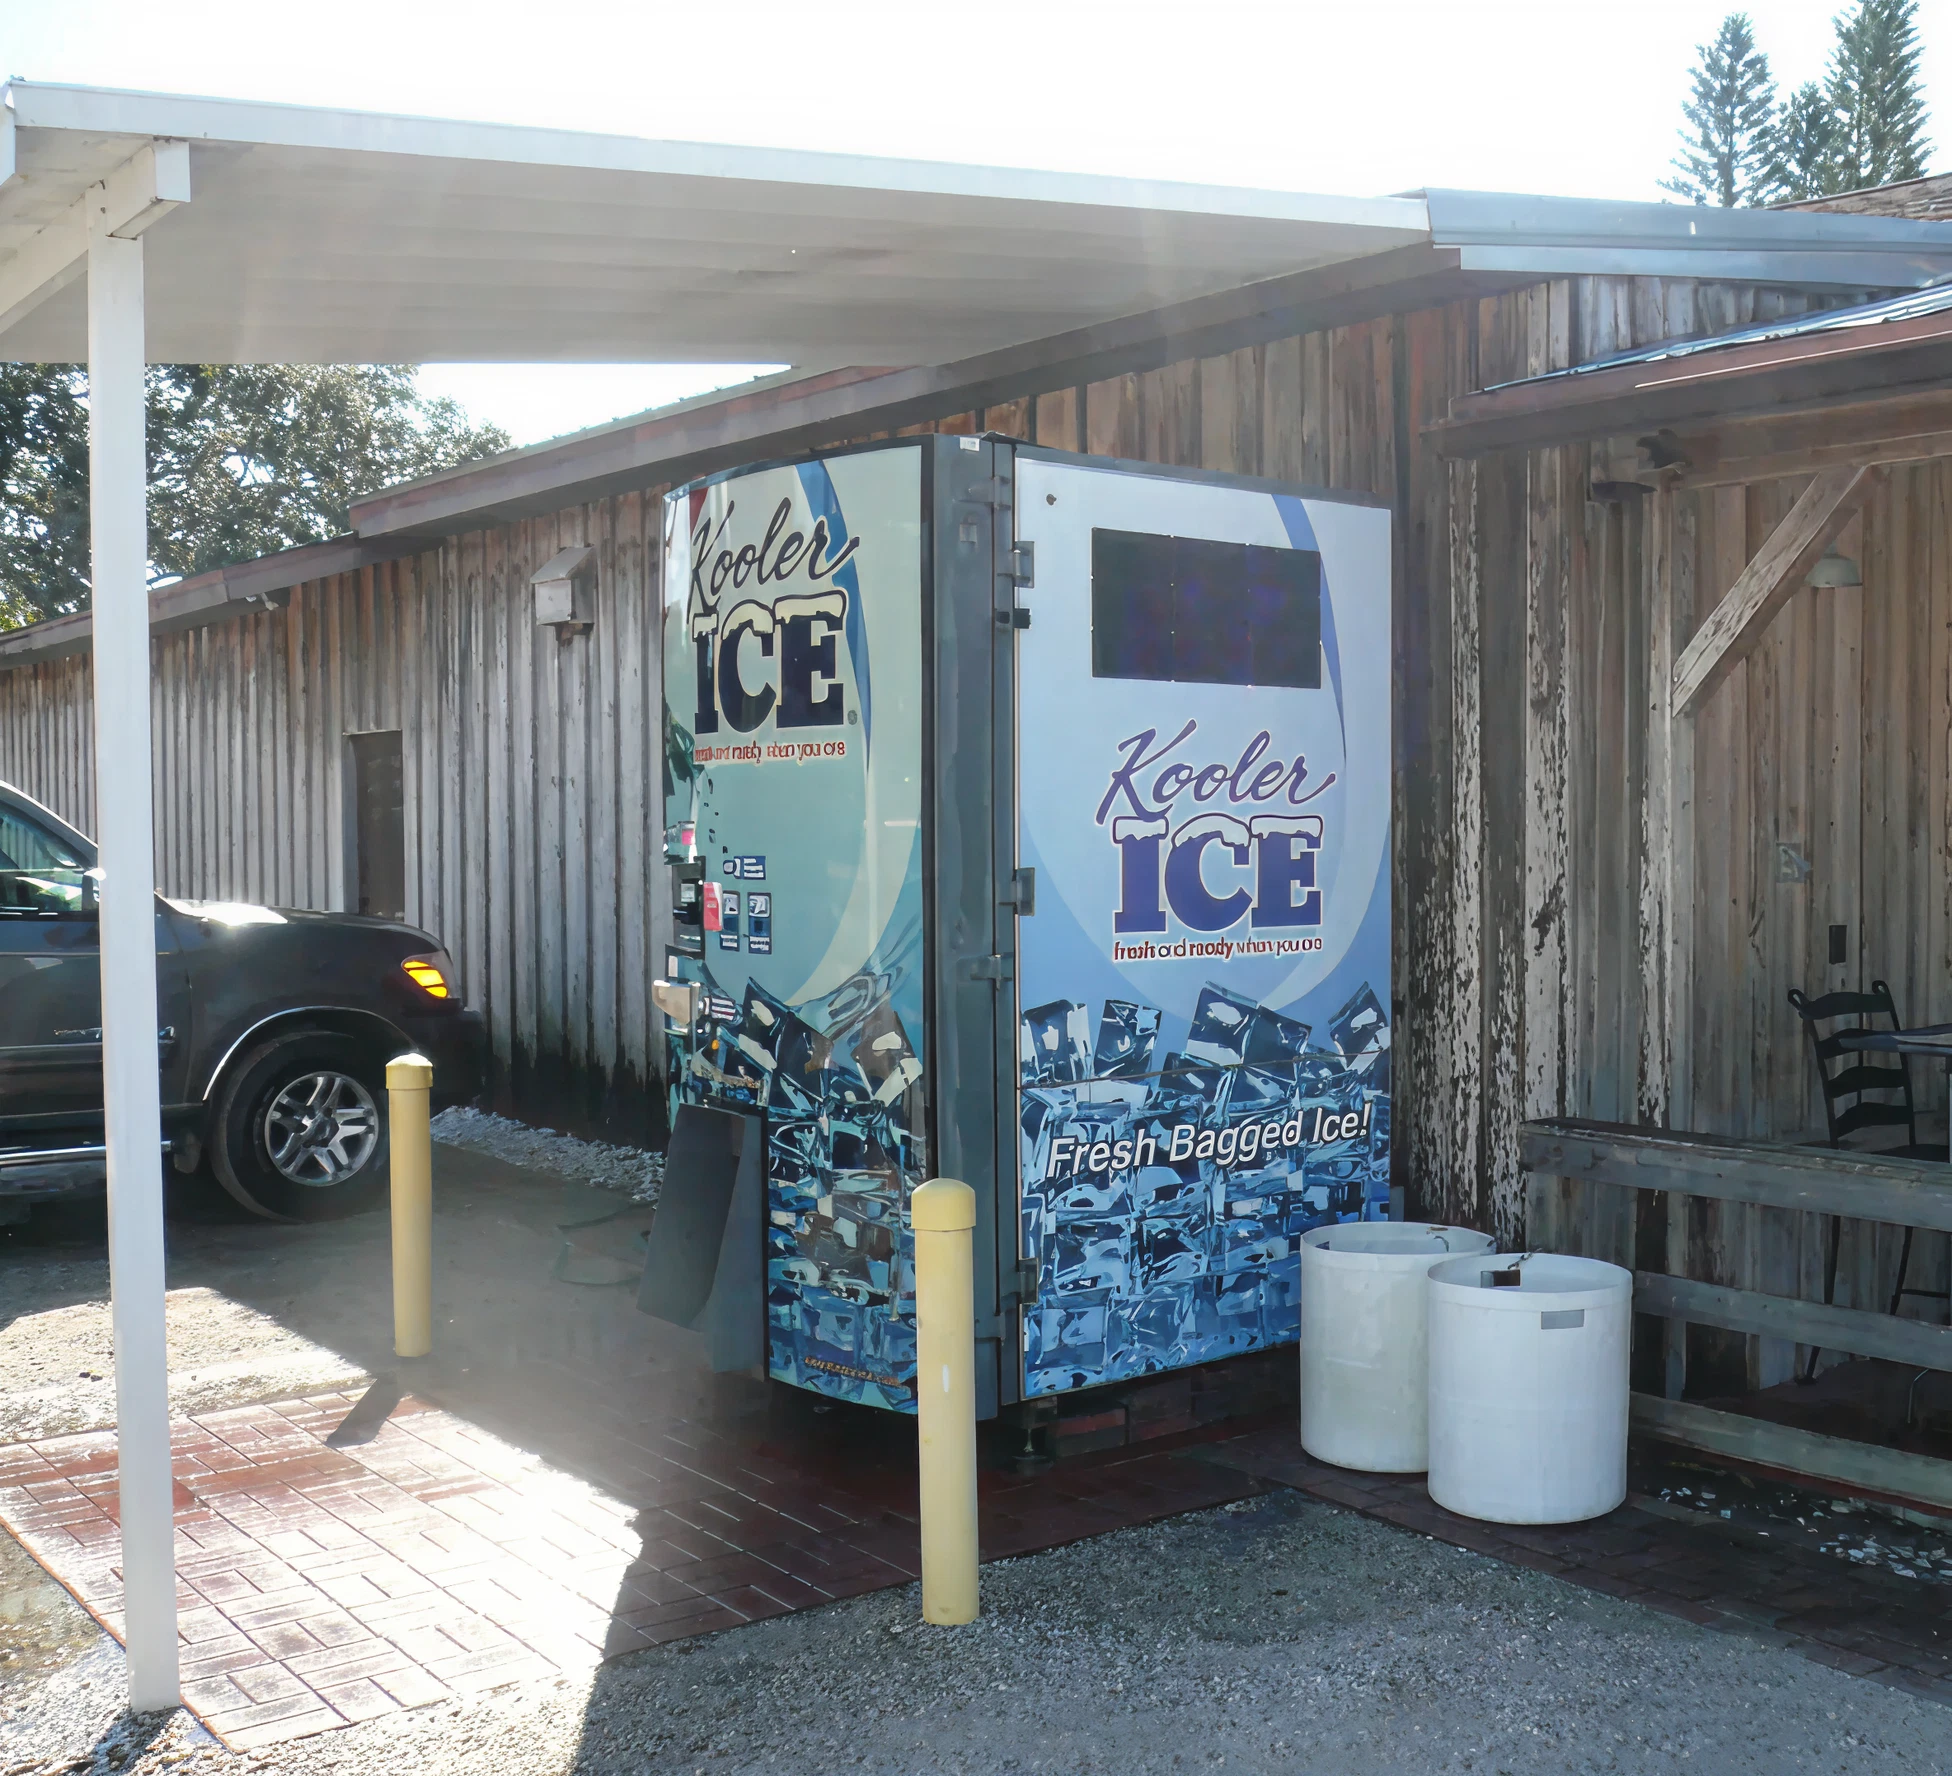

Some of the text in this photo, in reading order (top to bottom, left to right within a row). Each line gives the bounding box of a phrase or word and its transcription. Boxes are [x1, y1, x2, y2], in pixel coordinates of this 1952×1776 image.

[687, 496, 860, 624] Kooler
[692, 590, 847, 735] ICE
[1095, 719, 1336, 825] Kooler
[1113, 813, 1323, 933] ICE
[1046, 1102, 1372, 1178] Fresh Bagged Ice!
